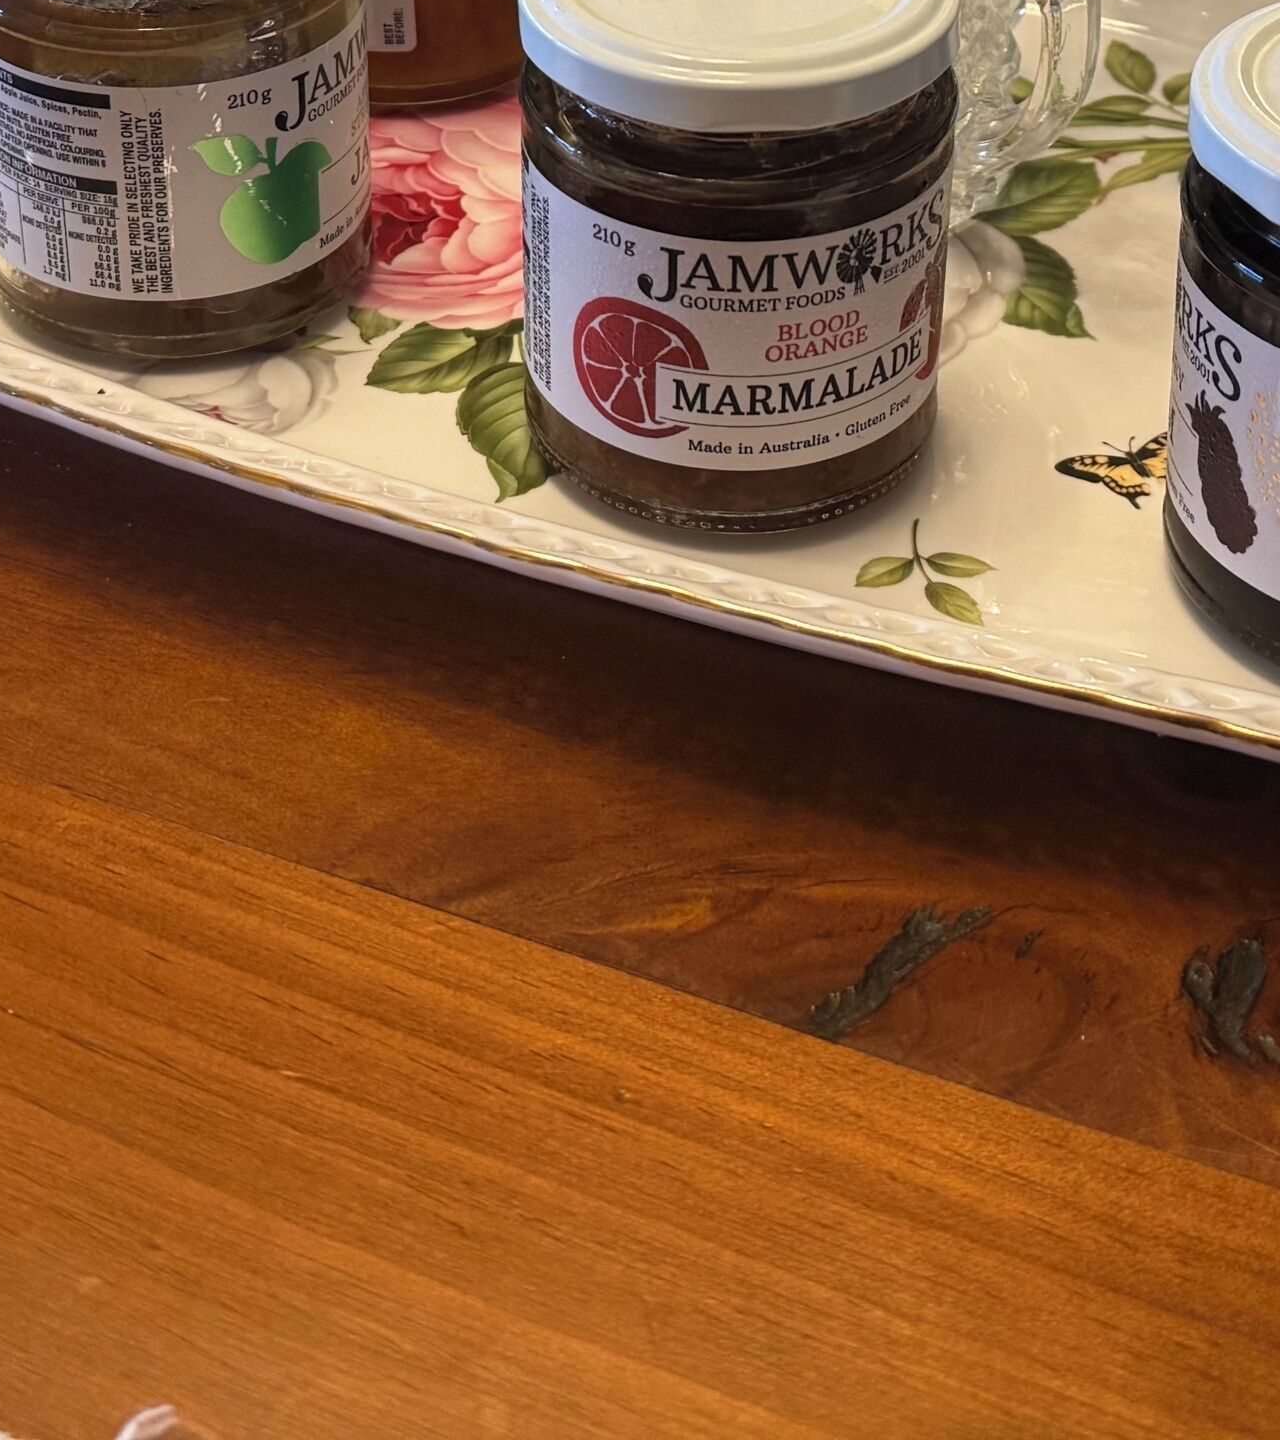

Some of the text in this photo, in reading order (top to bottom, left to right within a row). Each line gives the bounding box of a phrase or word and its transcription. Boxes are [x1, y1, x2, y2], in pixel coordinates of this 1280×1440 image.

[383, 22, 396, 45] BEST
[393, 7, 405, 45] BEFORE:
[41, 99, 71, 116] Spices,
[72, 106, 102, 120] Pectin,
[227, 87, 273, 110] 210 g
[307, 76, 359, 123] GOURMET
[24, 122, 51, 137] GLUTEN
[44, 118, 77, 135] FACILITY
[78, 127, 99, 138] THAT
[25, 132, 59, 150] ARTIFICIAL
[59, 142, 107, 159] COLOURING.
[56, 150, 71, 162] USE
[73, 155, 100, 168] WITHIN
[23, 186, 61, 206] PER SERVE
[43, 181, 78, 199] SERVING
[80, 192, 102, 202] SIZE:
[119, 109, 145, 294] WE TAKE PRIDE IN SELECTING ONLY
[134, 116, 159, 294] THE BEST AND FRESHEST QUALITY
[148, 108, 174, 294] INGREDIENTS FOR OUR PRESERVES.
[71, 202, 90, 213] PER
[85, 234, 118, 246] DETECTED
[96, 226, 110, 236] 0.2
[319, 214, 356, 249] Made in
[592, 223, 636, 257] 210 g
[98, 244, 111, 254] 0.0
[98, 253, 111, 263] 0.0
[900, 249, 927, 276] 2001
[89, 278, 106, 289] 11.0
[680, 285, 846, 313] GOURMET FOODS
[776, 309, 861, 343] BLOOD
[764, 324, 869, 363] ORANGE
[672, 328, 922, 417] MARMALADE
[1190, 350, 1211, 385] 2001
[687, 393, 912, 455] Made in Australia Gluten Free
